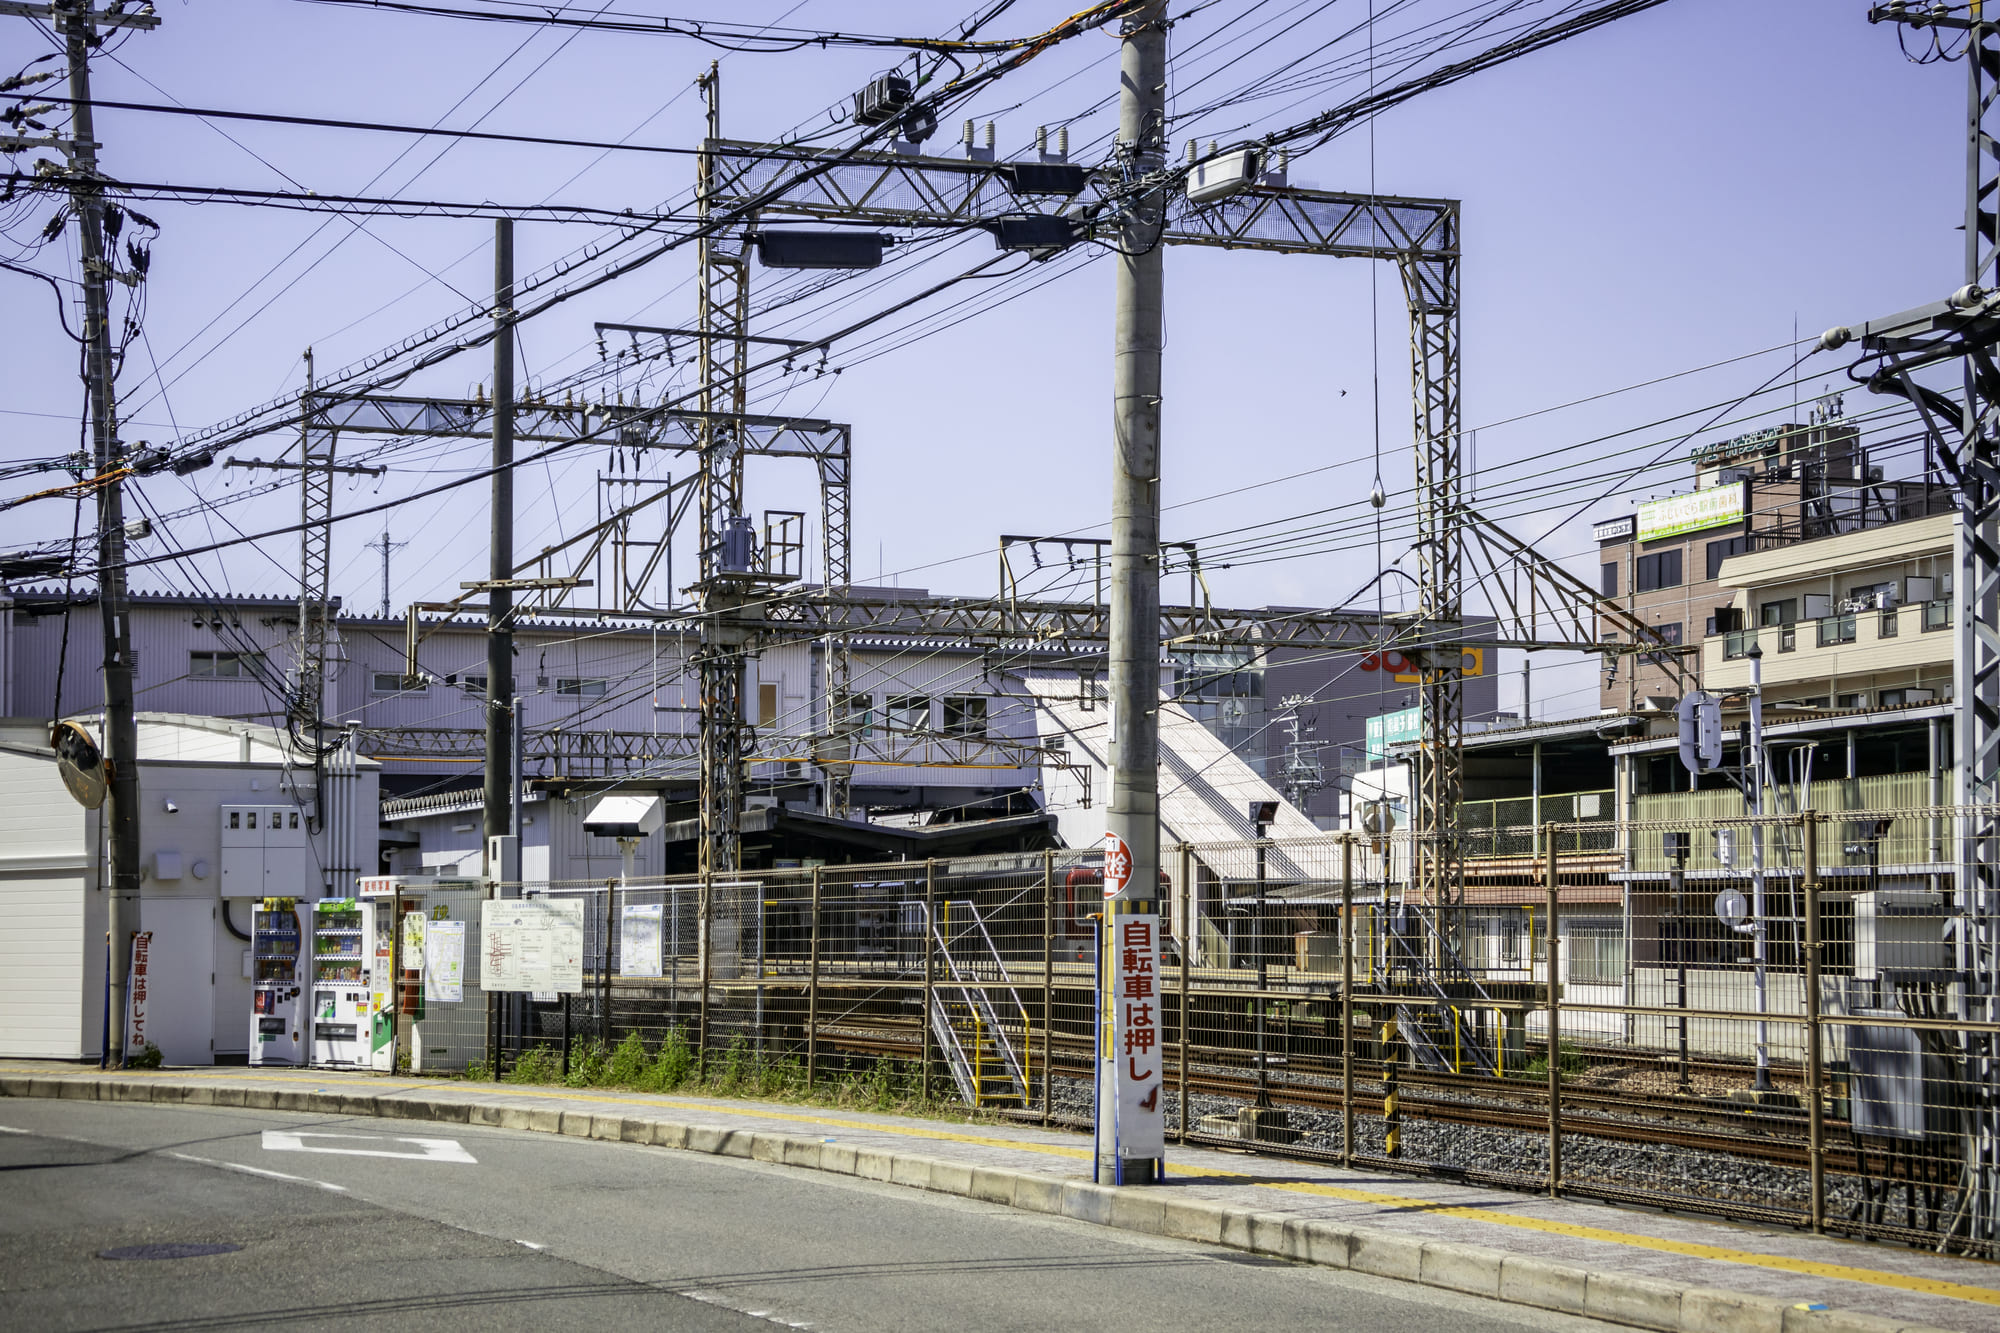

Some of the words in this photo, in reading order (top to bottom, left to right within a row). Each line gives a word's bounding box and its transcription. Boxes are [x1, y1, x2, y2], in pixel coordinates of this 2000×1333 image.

[131, 936, 149, 1046] 自転車は押してね
